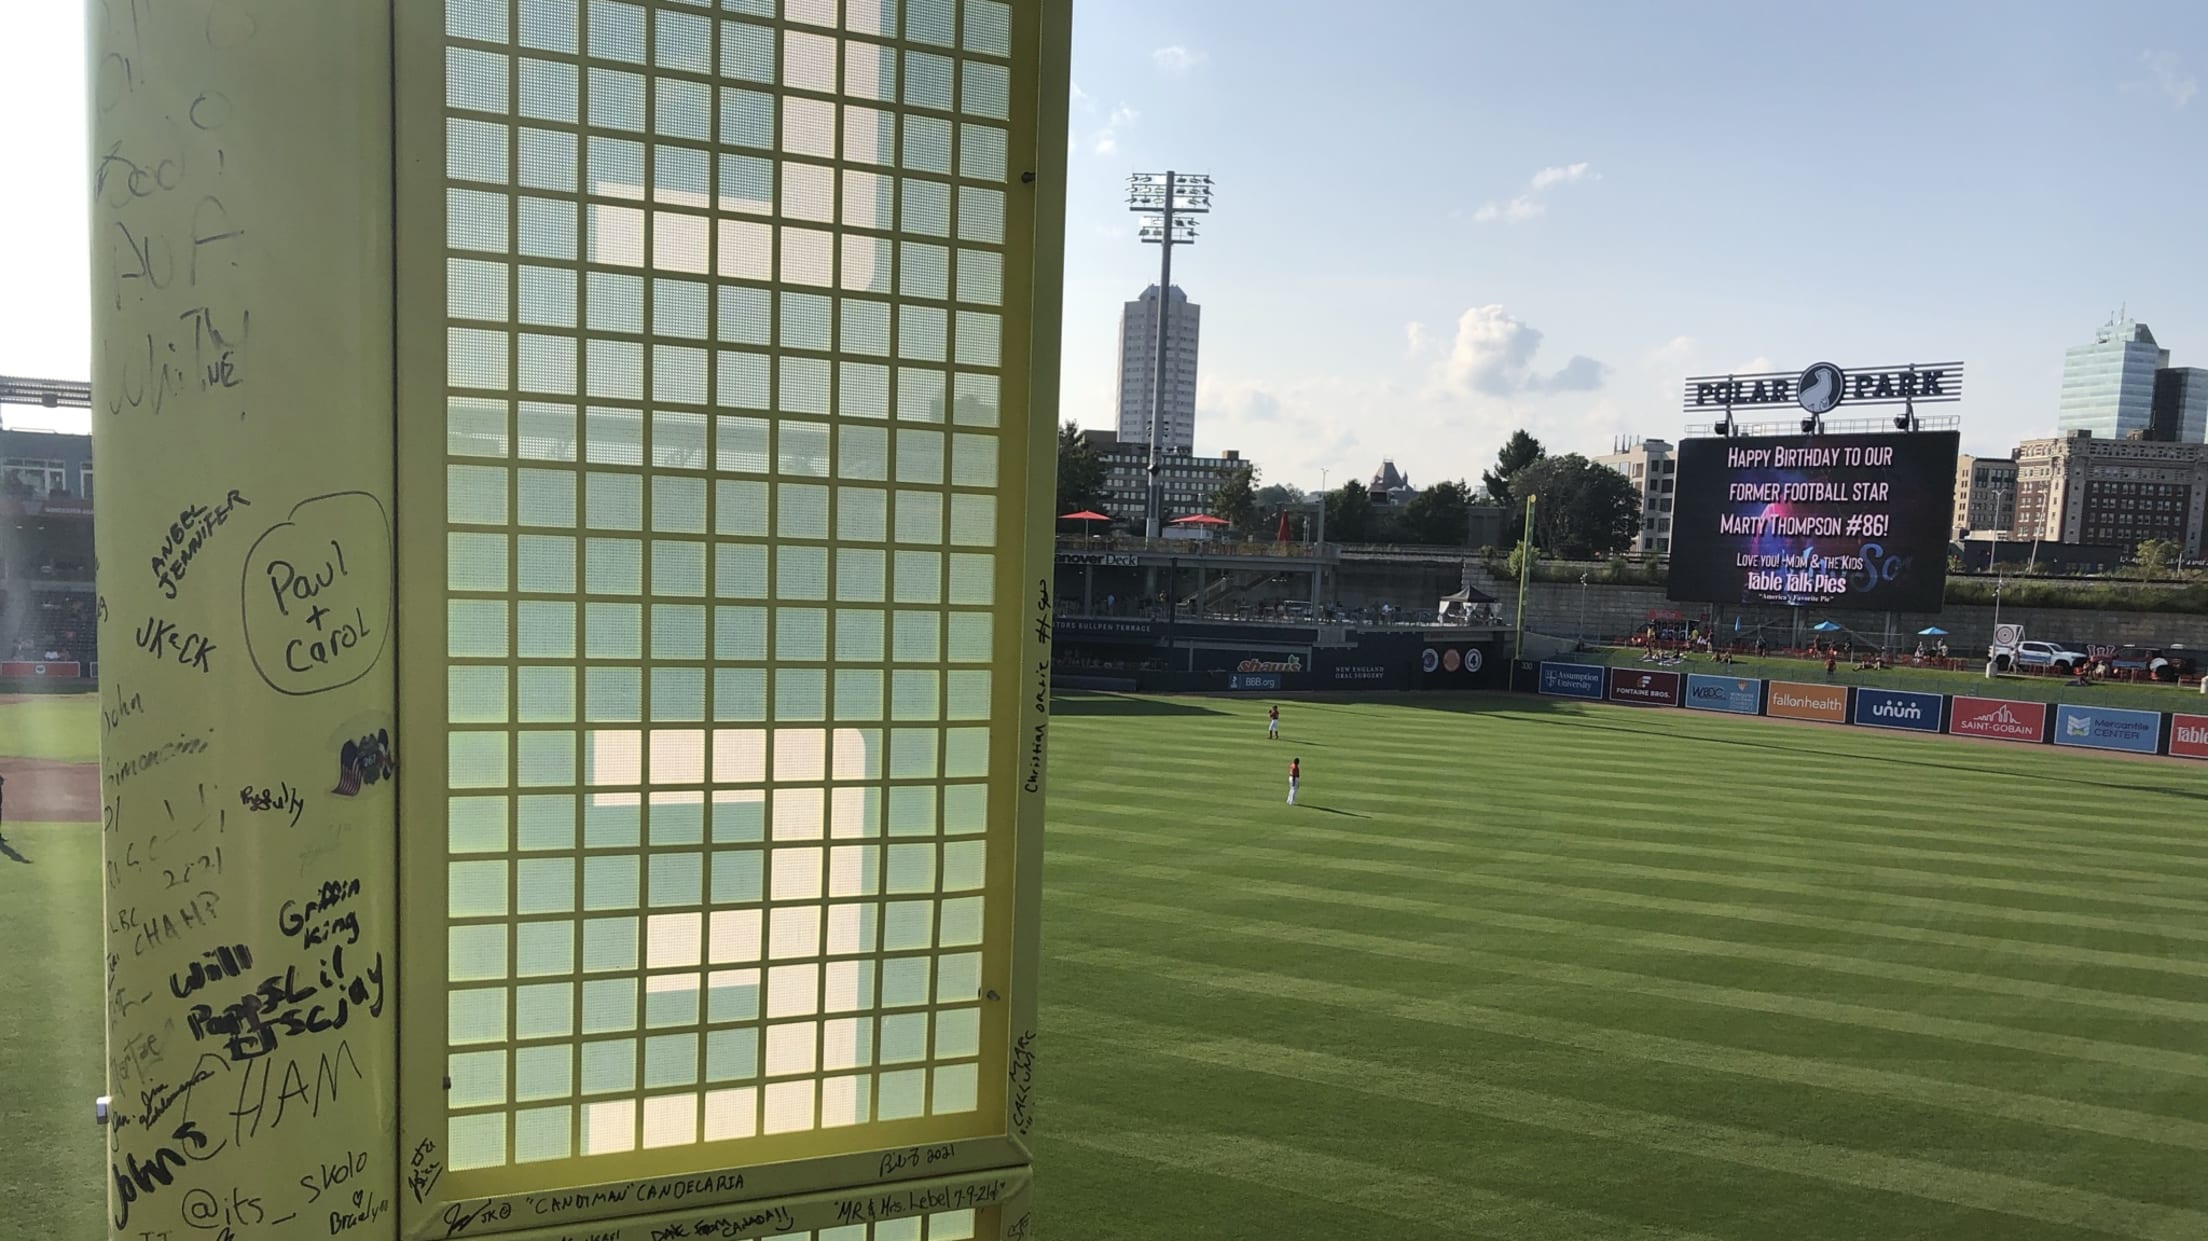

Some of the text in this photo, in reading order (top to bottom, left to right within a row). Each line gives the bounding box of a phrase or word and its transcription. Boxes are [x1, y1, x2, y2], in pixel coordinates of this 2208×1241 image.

[1697, 371, 1944, 405] POLAR PARK
[1727, 446, 1894, 468] HAPPY BIRTHDAY TO OUR
[1729, 482, 1890, 501] FORMER FOOTBALL STAR
[1720, 513, 1890, 537] MARTY THOMPSON #86!
[159, 489, 251, 599] JENNIFER
[1106, 553, 1136, 566] Deck
[1736, 551, 1759, 567] LOVE
[1760, 553, 1780, 568] YOU!
[1810, 553, 1821, 569] &
[1823, 556, 1840, 569] THE
[1841, 555, 1864, 570] KIDS
[267, 540, 348, 616] Paul
[1748, 571, 1847, 594] Table Talk Pies
[1557, 671, 1599, 682] Assumption
[1557, 679, 1593, 691] University
[1616, 687, 1671, 699] FONTAINE BROS.
[1773, 692, 1842, 712] fallonhealth
[1961, 720, 2033, 735] SAINT-GOBAIN
[2094, 719, 2149, 731] Mercantile
[2094, 729, 2140, 740] CENTER
[636, 1174, 745, 1201] CANDELARIA
